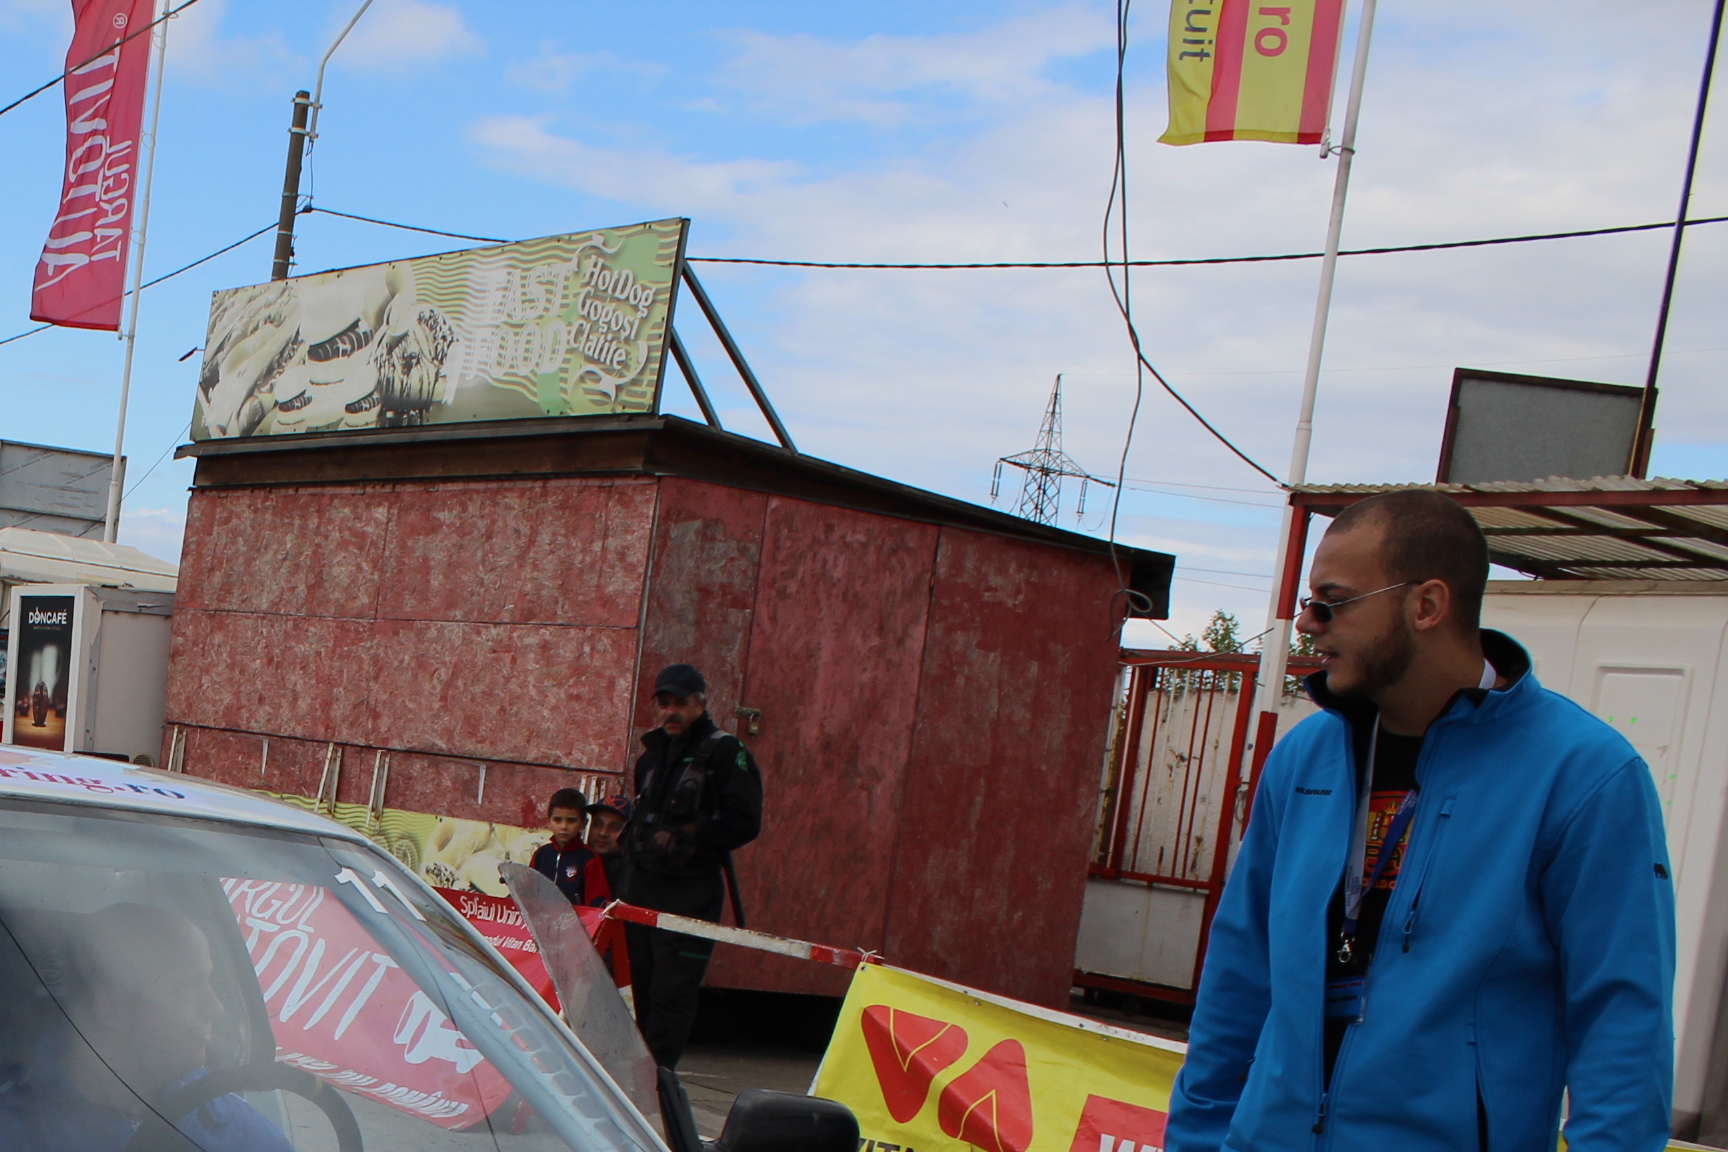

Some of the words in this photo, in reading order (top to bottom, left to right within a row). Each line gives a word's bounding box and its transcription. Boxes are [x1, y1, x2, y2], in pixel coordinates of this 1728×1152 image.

[1178, 0, 1214, 62] uit
[484, 263, 572, 321] FAST
[466, 320, 568, 380] FOOD
[246, 914, 400, 1040] TOVIT
